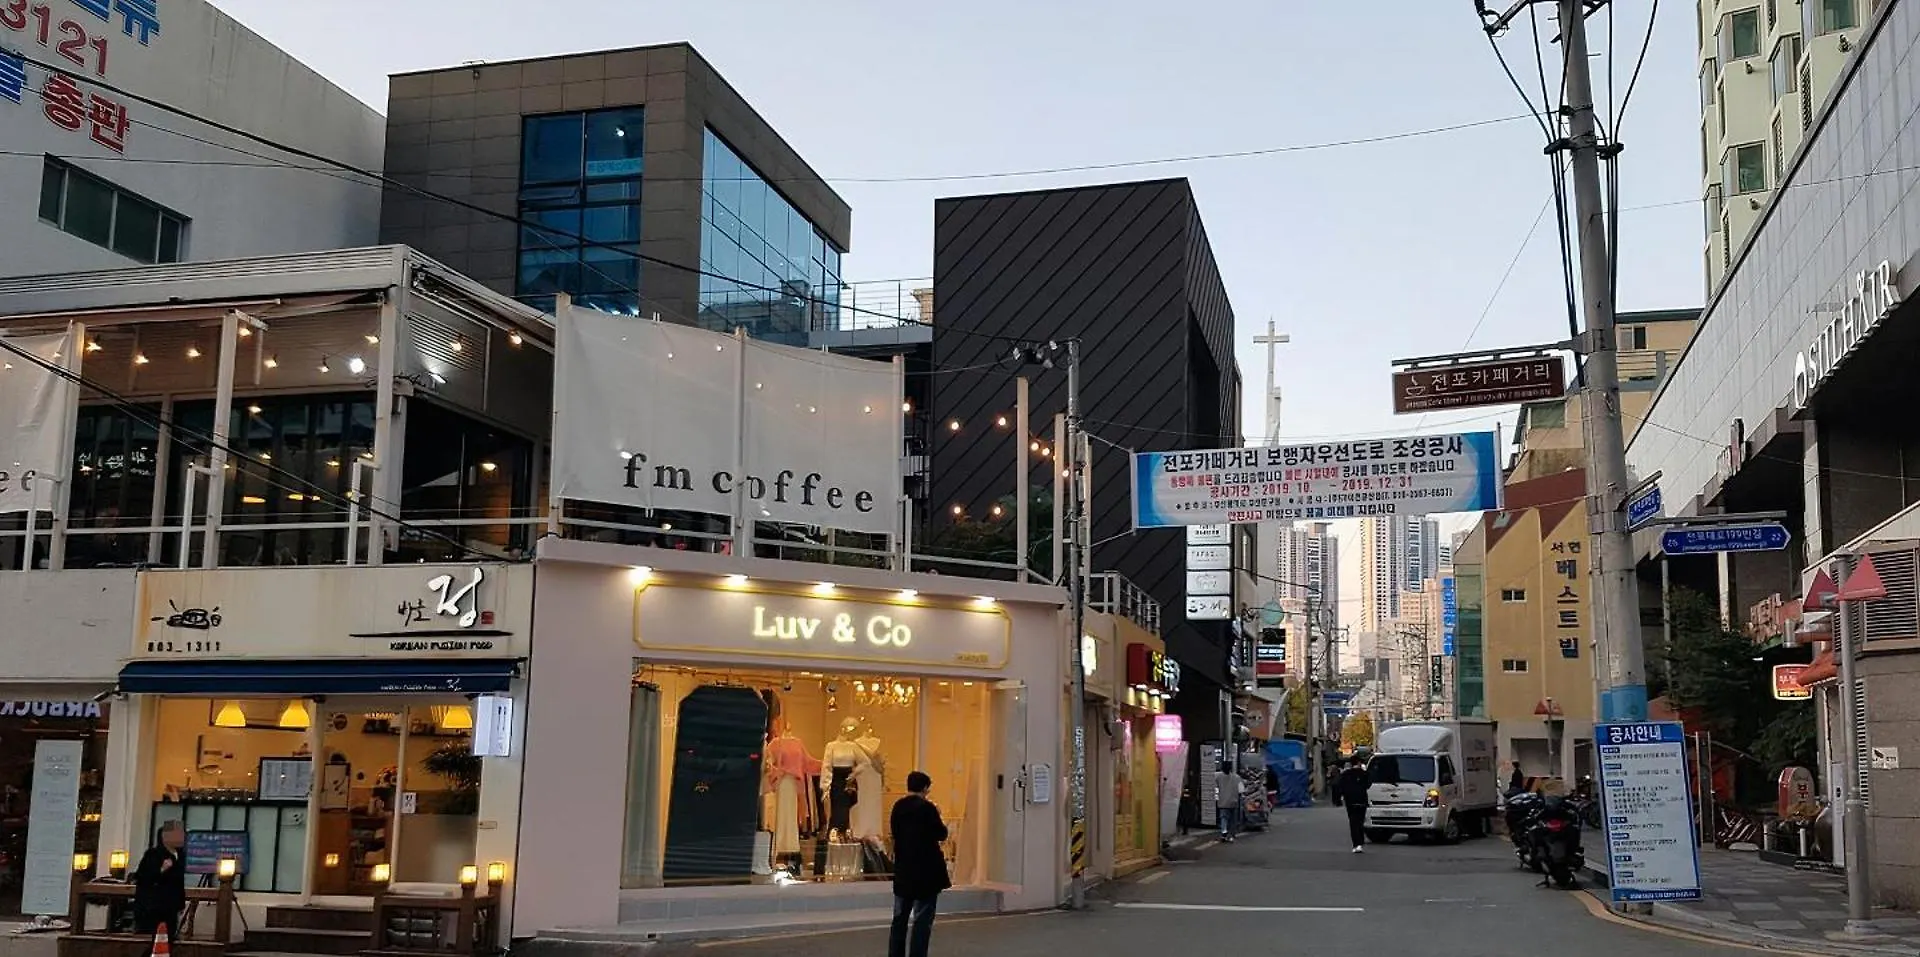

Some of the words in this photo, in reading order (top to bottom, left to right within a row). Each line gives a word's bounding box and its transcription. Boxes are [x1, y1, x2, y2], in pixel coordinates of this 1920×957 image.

[42, 68, 130, 153] 총판
[1431, 363, 1550, 392] 전포카페거리
[1163, 450, 1258, 472] 전포카페거리
[1267, 442, 1385, 466] 보행자우선도로
[1392, 435, 1463, 458] 조성공사
[623, 453, 694, 491] fm
[712, 469, 874, 513] coffee
[1210, 484, 1250, 499] 공사기간
[1399, 476, 1413, 488] 31
[753, 606, 820, 640] Luv
[831, 612, 857, 643] &
[867, 615, 912, 647] Co
[1555, 559, 1580, 659] 베스트빌
[1609, 724, 1663, 744] 공사안내
